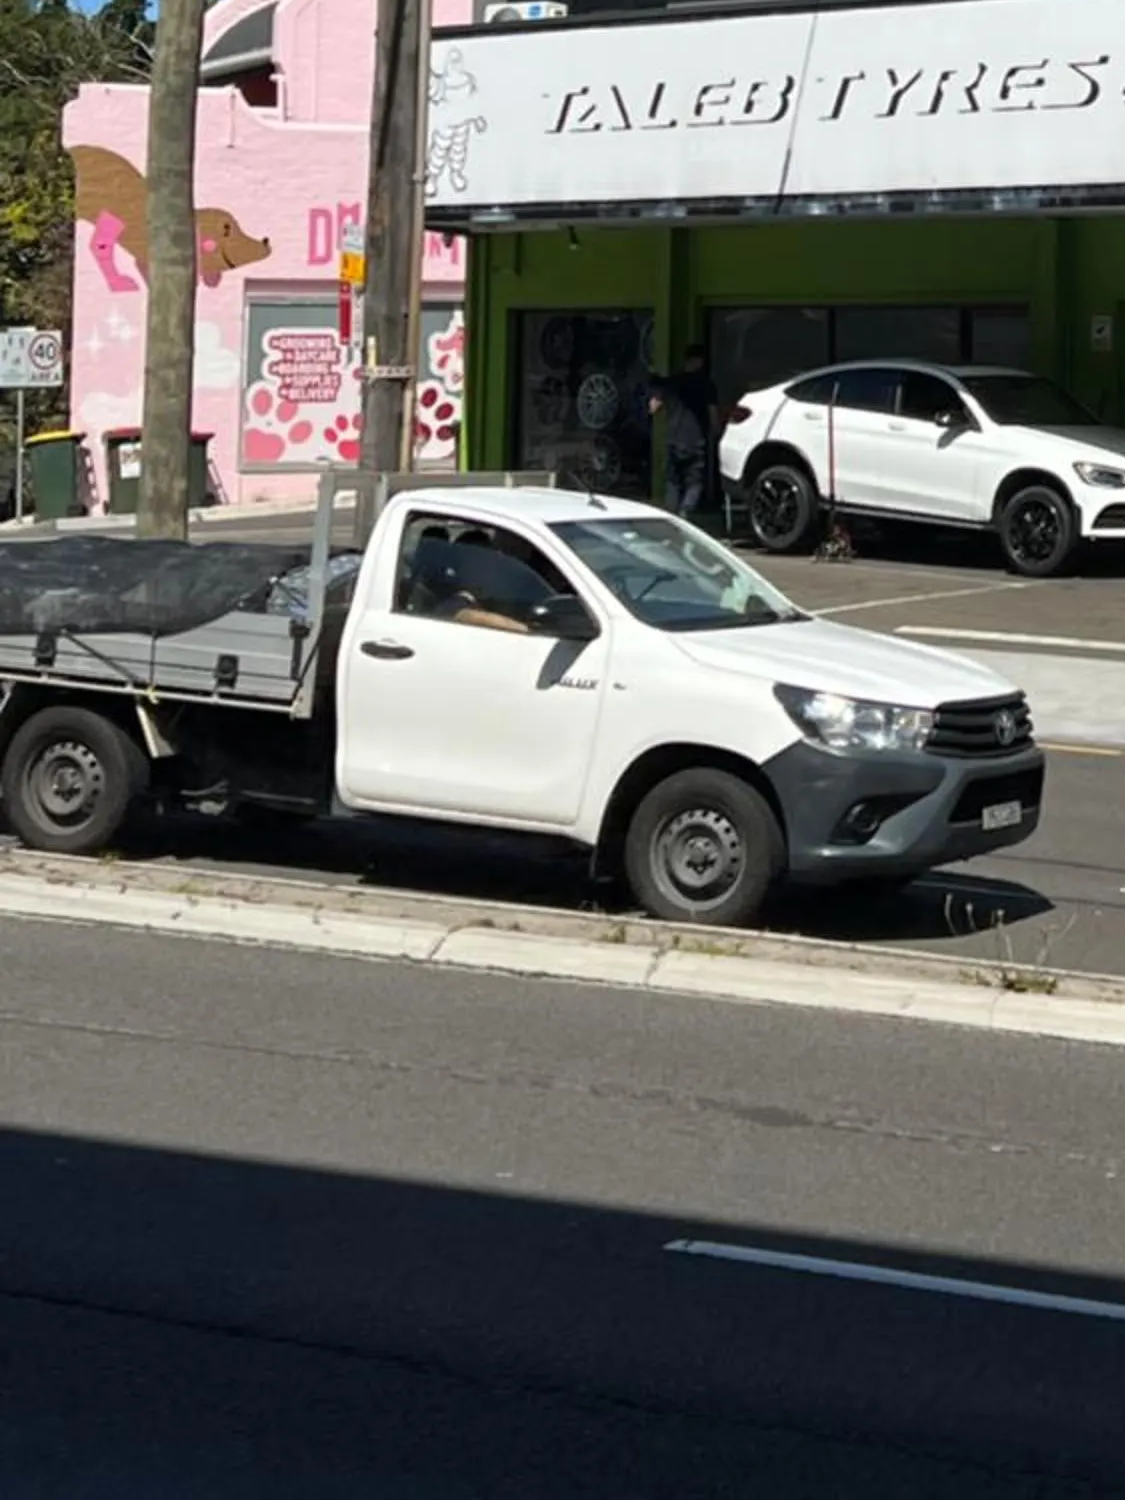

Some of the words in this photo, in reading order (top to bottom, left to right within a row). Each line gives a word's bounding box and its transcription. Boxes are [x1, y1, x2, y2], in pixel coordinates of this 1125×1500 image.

[541, 74, 796, 135] TALEB
[814, 54, 1110, 122] TYRES
[35, 341, 56, 360] 40
